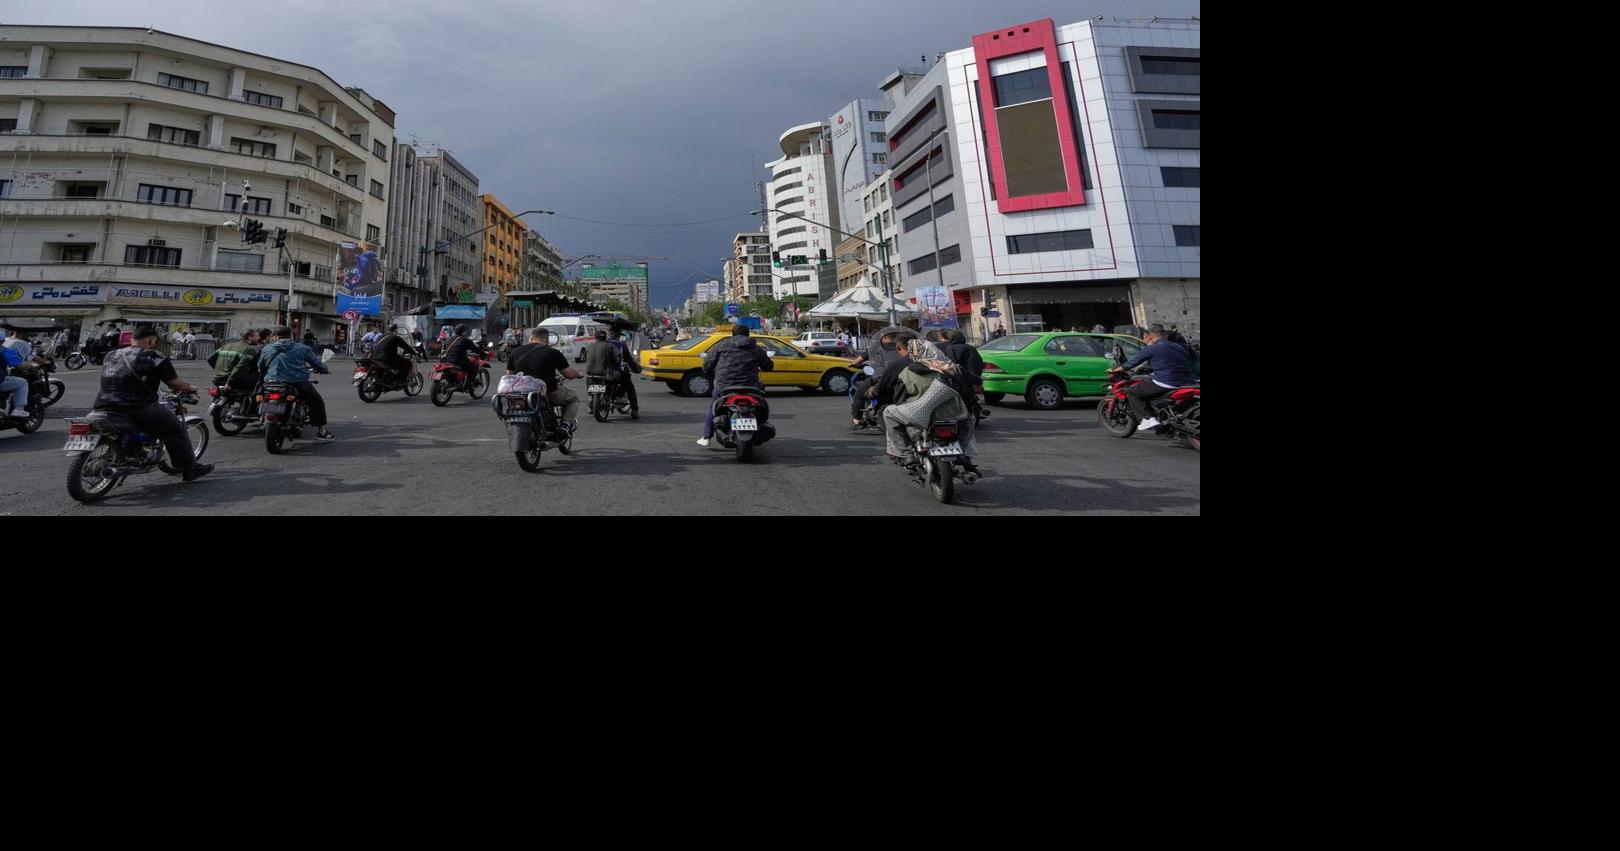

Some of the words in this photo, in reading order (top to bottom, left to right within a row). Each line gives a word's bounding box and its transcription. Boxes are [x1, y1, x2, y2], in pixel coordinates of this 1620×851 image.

[60, 285, 99, 298] کفش
[116, 288, 180, 300] MELLI
[240, 293, 273, 303] کفش
